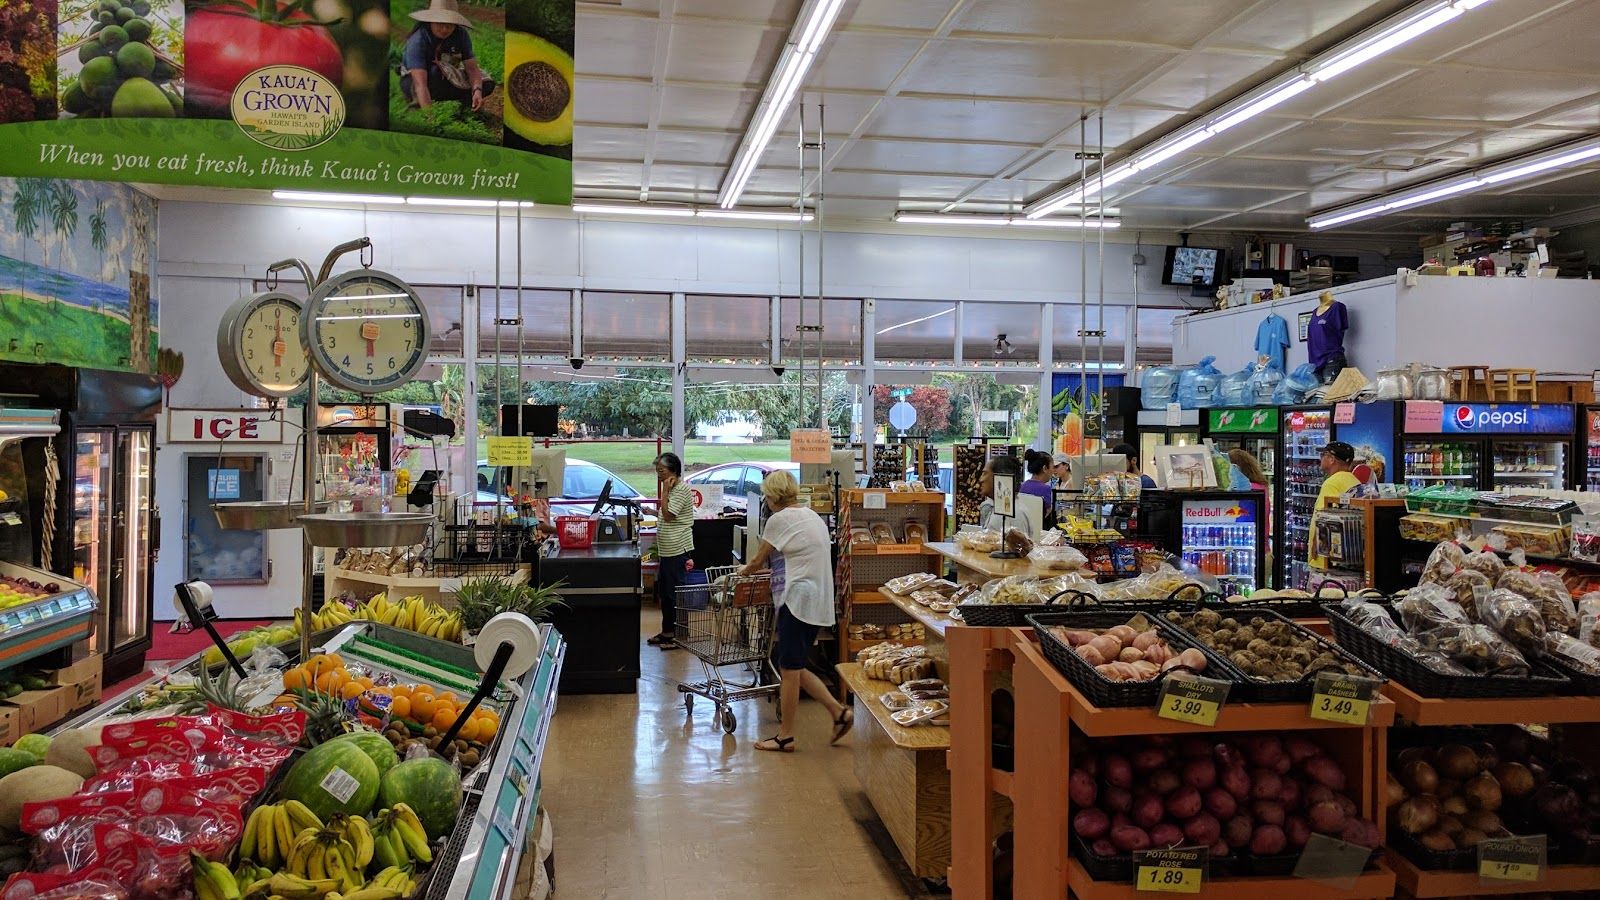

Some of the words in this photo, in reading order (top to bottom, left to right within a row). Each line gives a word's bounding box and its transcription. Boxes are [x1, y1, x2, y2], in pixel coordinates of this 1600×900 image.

[243, 90, 332, 115] GROWN
[292, 121, 320, 129] ISLAND
[39, 144, 104, 165] When
[112, 153, 150, 171] you
[157, 154, 188, 170] eat
[195, 153, 255, 177] fresh,
[260, 157, 313, 177] think
[397, 165, 465, 186] Grown
[472, 168, 520, 189] first!
[1478, 409, 1527, 428] pepsi
[193, 416, 259, 439] ICE
[210, 480, 238, 492] ICE
[1186, 507, 1202, 517] Red
[1204, 507, 1221, 517] Bull
[1178, 680, 1215, 693] SHALLOTS
[1186, 691, 1201, 699] DRY
[1171, 698, 1202, 715] 3.99
[1321, 698, 1352, 714] 3.49
[1146, 850, 1178, 859] POTATO
[1159, 860, 1182, 868] ROSE
[1150, 870, 1183, 884] 1.89
